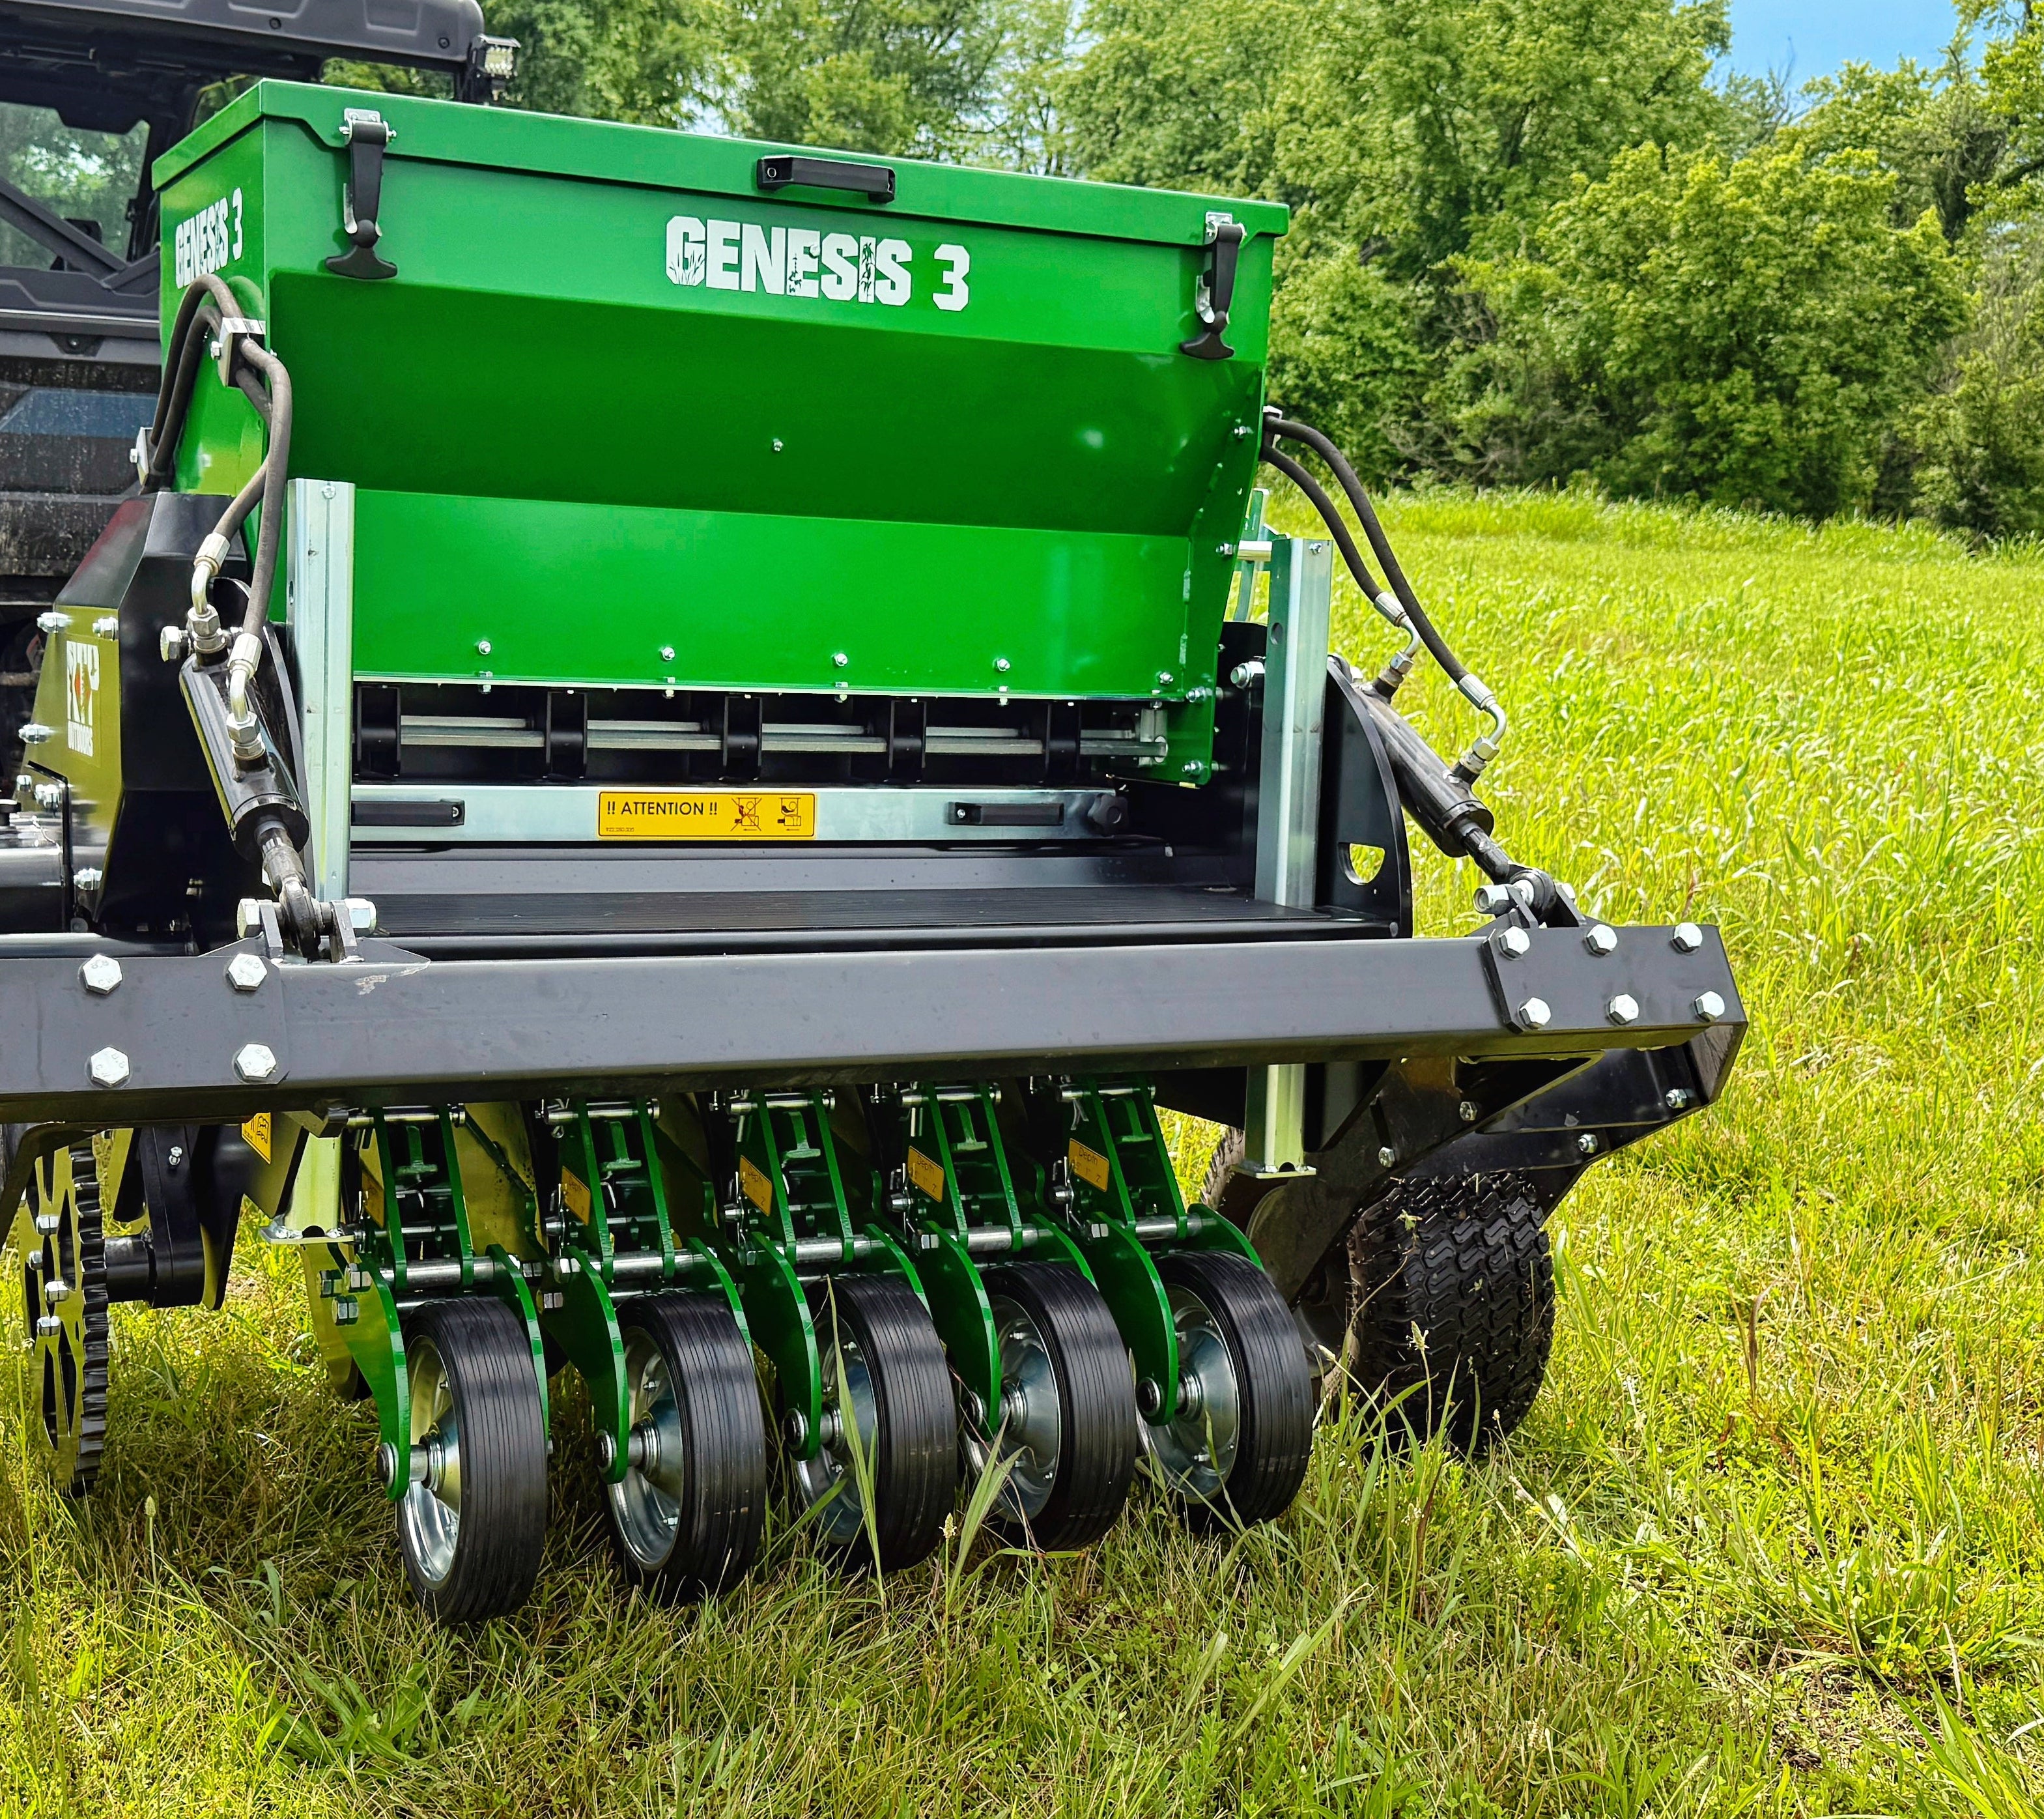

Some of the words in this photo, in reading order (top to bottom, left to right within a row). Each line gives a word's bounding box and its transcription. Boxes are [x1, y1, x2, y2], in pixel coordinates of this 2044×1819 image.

[175, 197, 228, 289] GENESIS
[233, 188, 242, 261] 3
[666, 216, 911, 306] GENESIS
[931, 244, 970, 311] 3
[607, 801, 615, 814] !!
[621, 801, 703, 815] ATTENTION
[709, 802, 717, 815] !!
